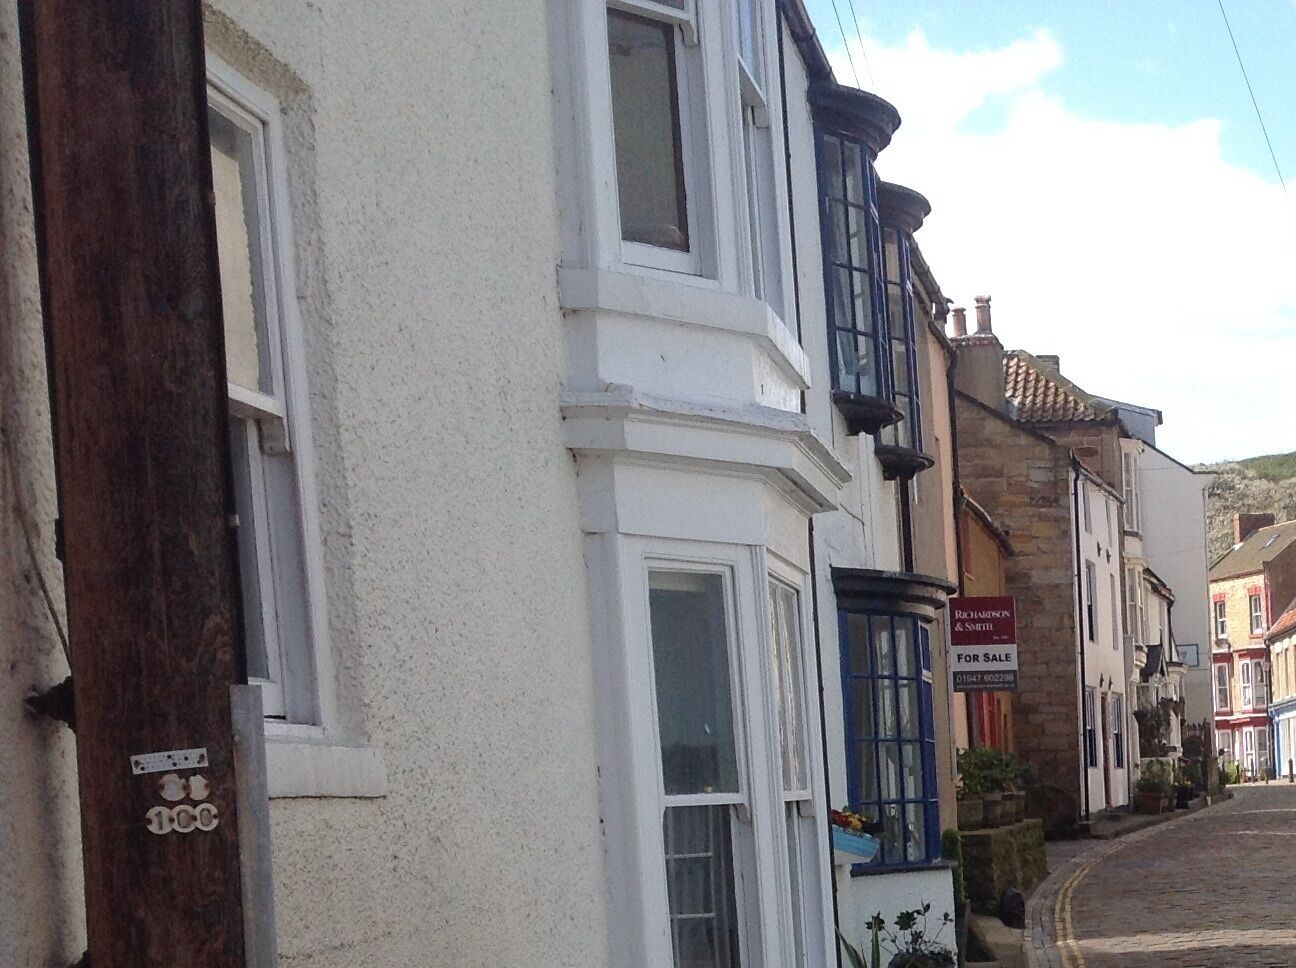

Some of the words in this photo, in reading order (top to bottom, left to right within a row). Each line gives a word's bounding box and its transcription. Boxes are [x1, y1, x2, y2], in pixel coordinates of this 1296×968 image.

[955, 610, 1011, 619] RICHARDSON
[955, 622, 963, 631] &
[965, 622, 993, 631] SMITH
[957, 653, 979, 663] FOR
[983, 653, 1012, 662] SALE
[956, 674, 981, 683] 01947
